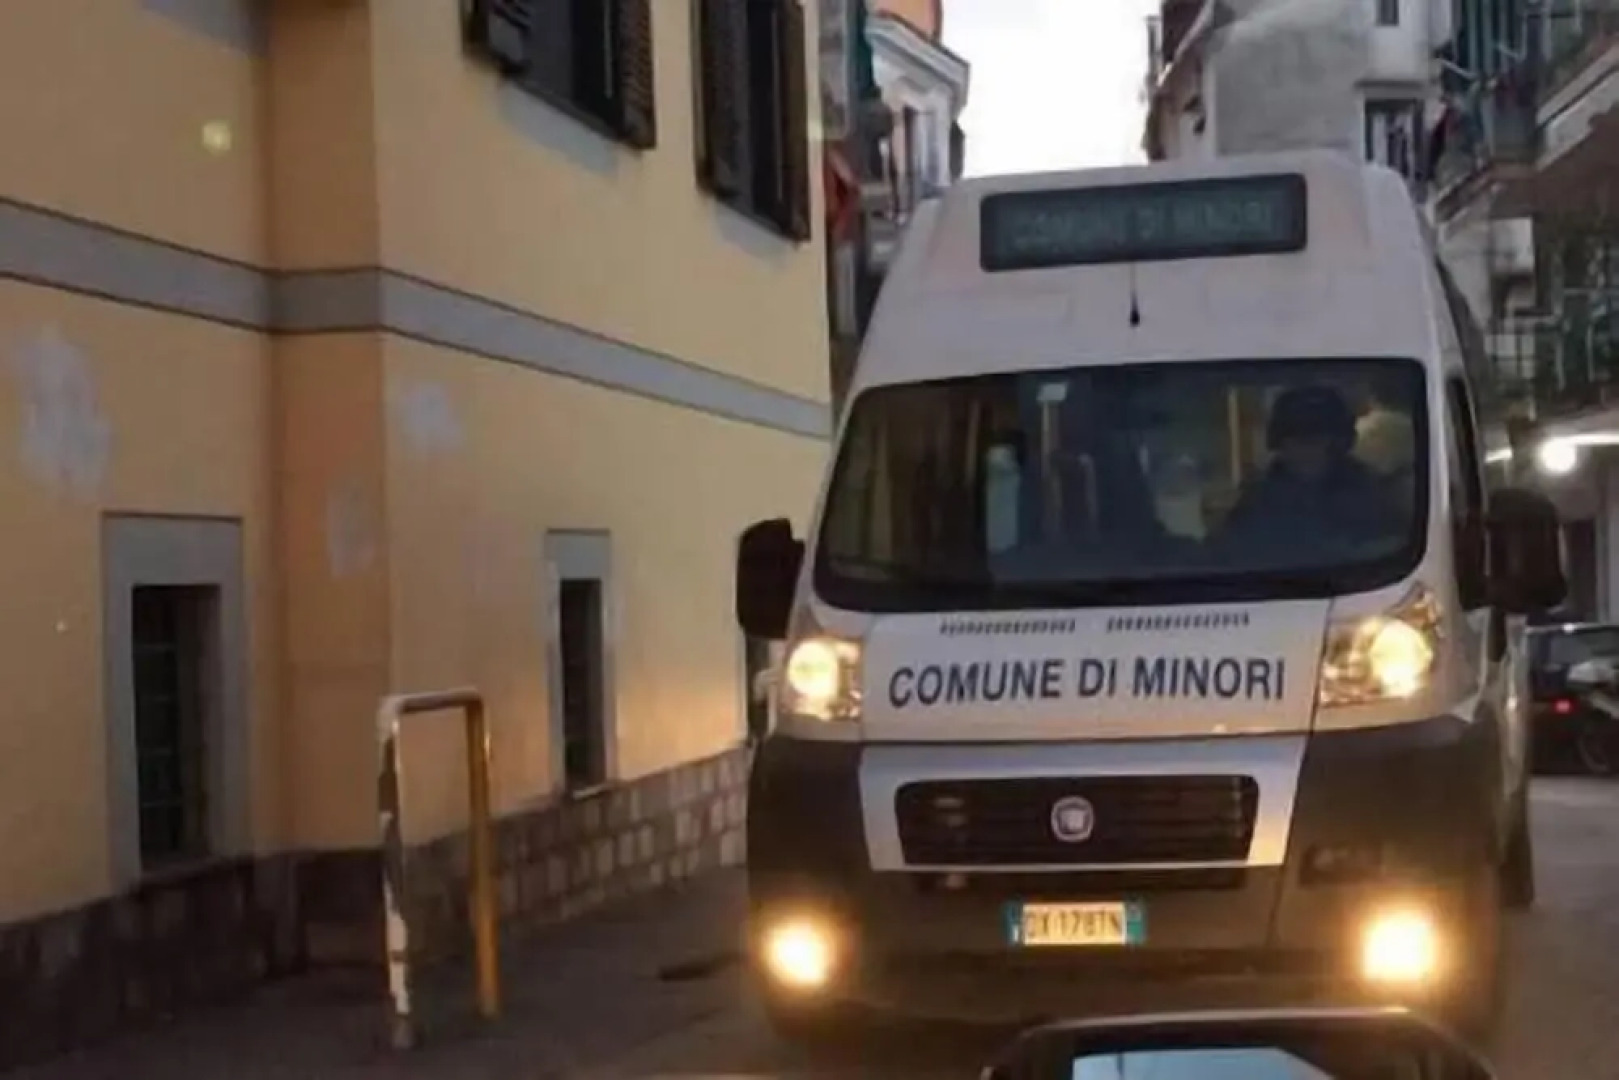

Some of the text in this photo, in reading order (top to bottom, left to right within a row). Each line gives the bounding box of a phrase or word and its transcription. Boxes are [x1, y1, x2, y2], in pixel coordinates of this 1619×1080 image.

[889, 656, 1286, 709] COMUNE DI MINORI
